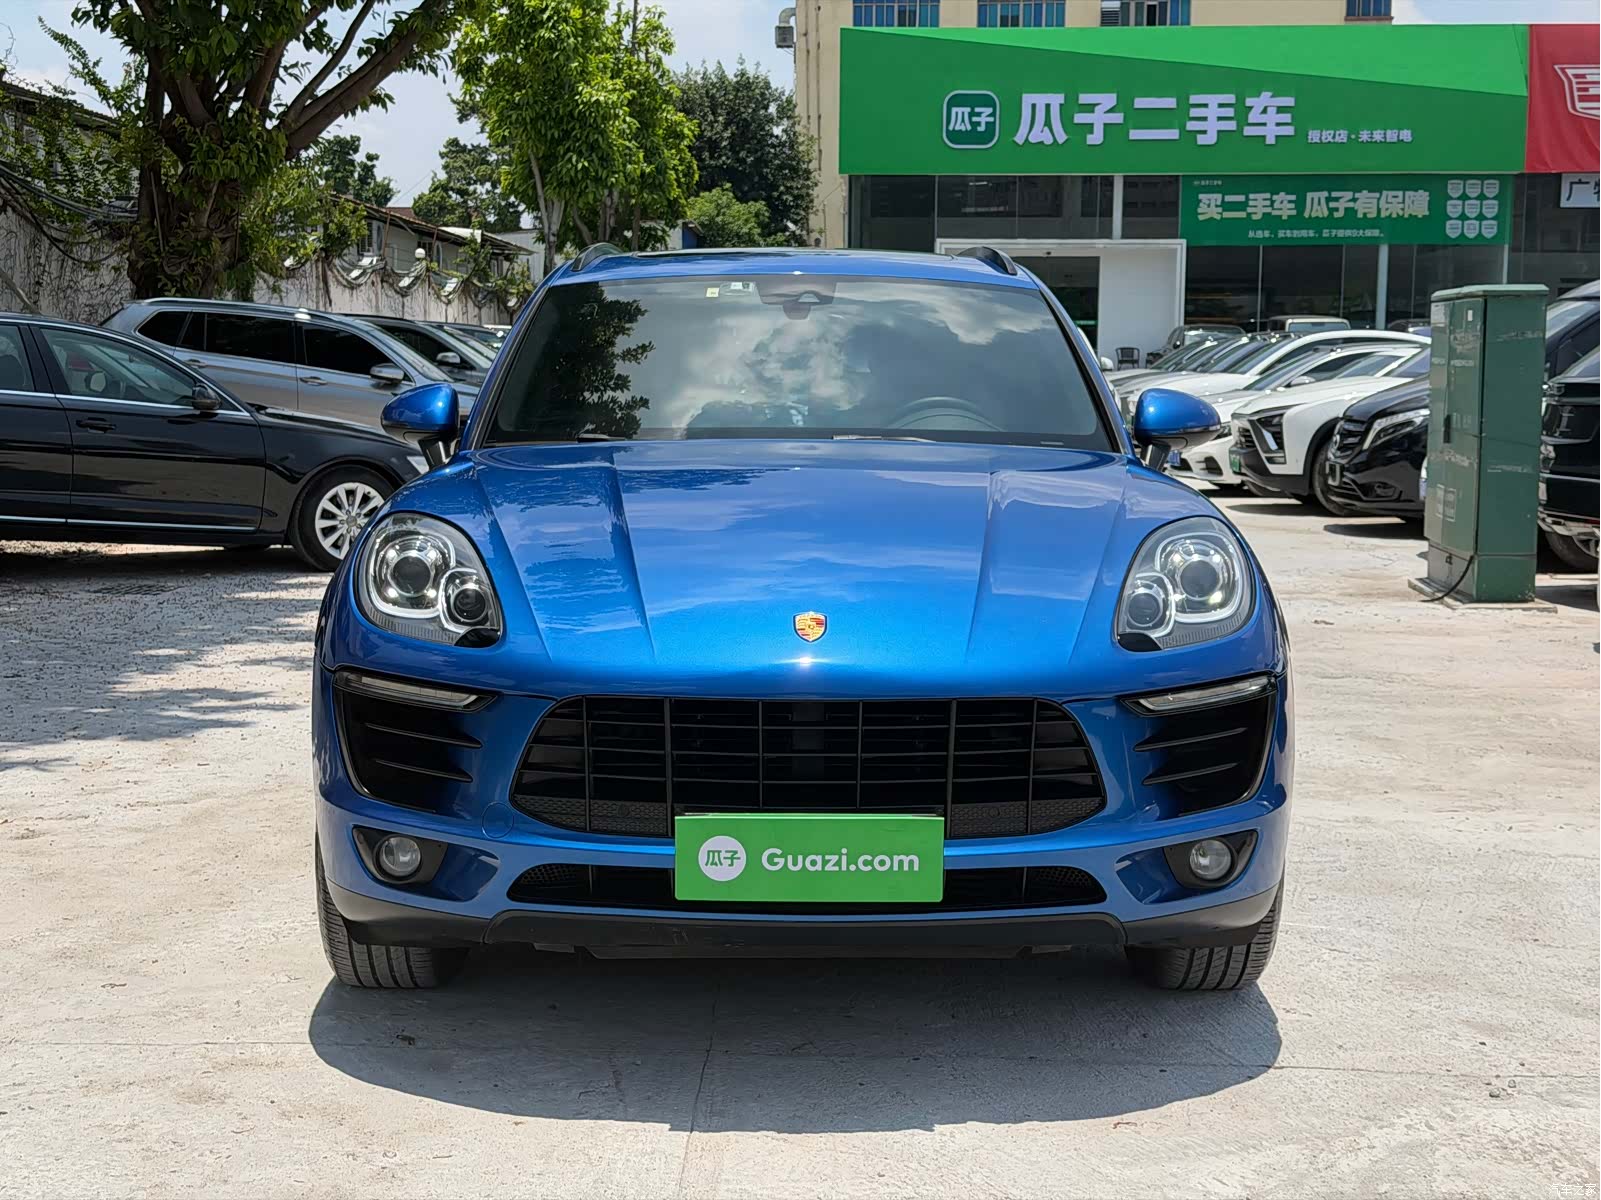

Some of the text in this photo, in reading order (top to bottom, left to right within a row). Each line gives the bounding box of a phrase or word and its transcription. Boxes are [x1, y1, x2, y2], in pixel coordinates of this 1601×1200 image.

[948, 107, 994, 132] 瓜子
[1013, 92, 1296, 145] 瓜子二手车
[1197, 190, 1430, 220] 买二手车 瓜子有保障
[704, 849, 741, 868] 瓜子
[761, 848, 919, 872] Guazi.com
